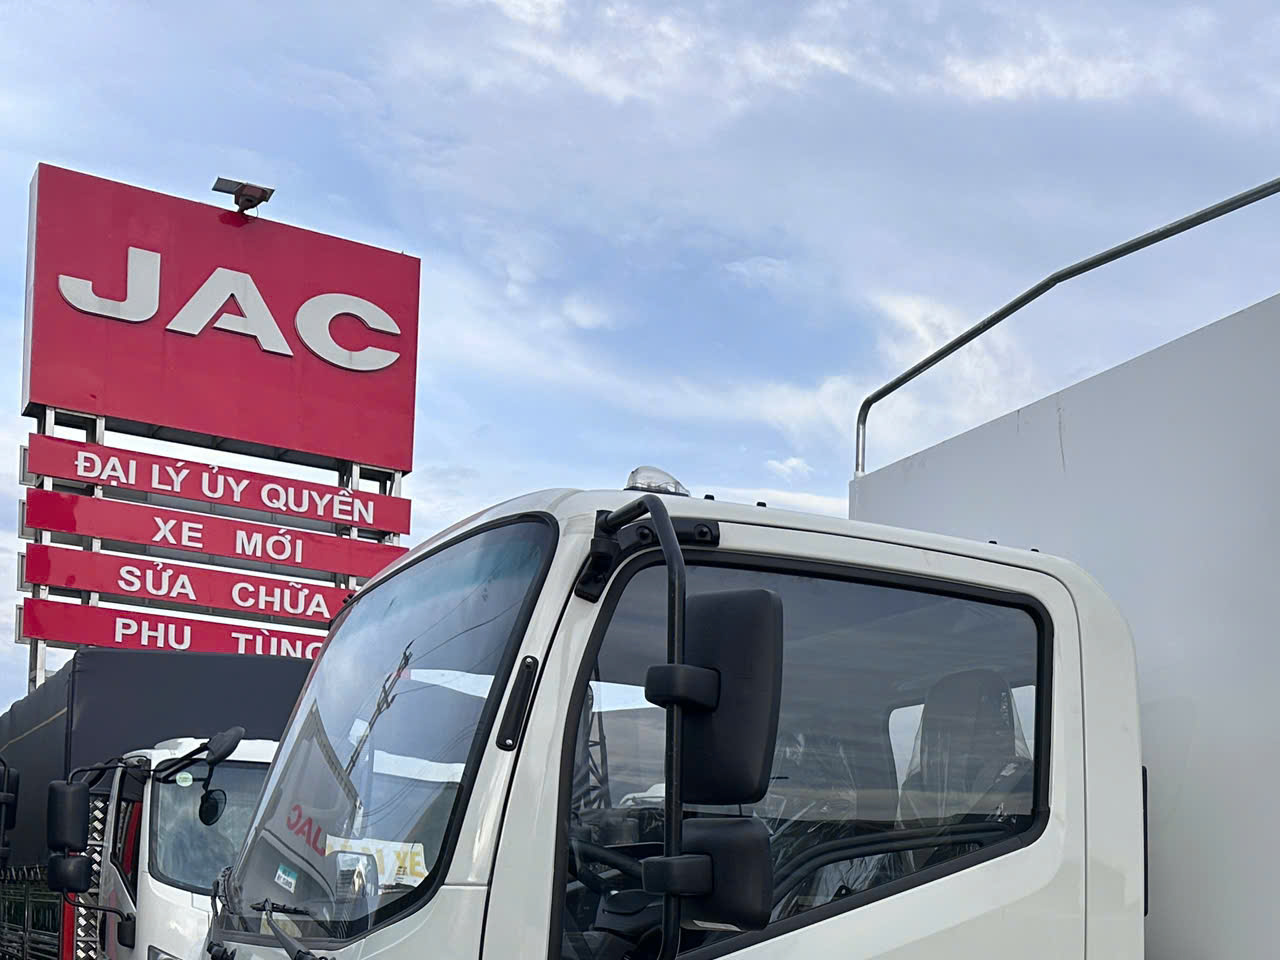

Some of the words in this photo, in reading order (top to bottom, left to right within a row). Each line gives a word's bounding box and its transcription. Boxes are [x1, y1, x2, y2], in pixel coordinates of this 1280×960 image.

[58, 246, 401, 372] JAC
[74, 451, 137, 487] ĐẠI
[151, 461, 190, 493] LÝ
[201, 464, 250, 503] ỦY
[260, 483, 374, 525] QUYỀN
[152, 517, 203, 549] XE
[236, 528, 303, 564] MỚI
[117, 561, 196, 601] SỬA
[231, 583, 331, 619] CHỮA
